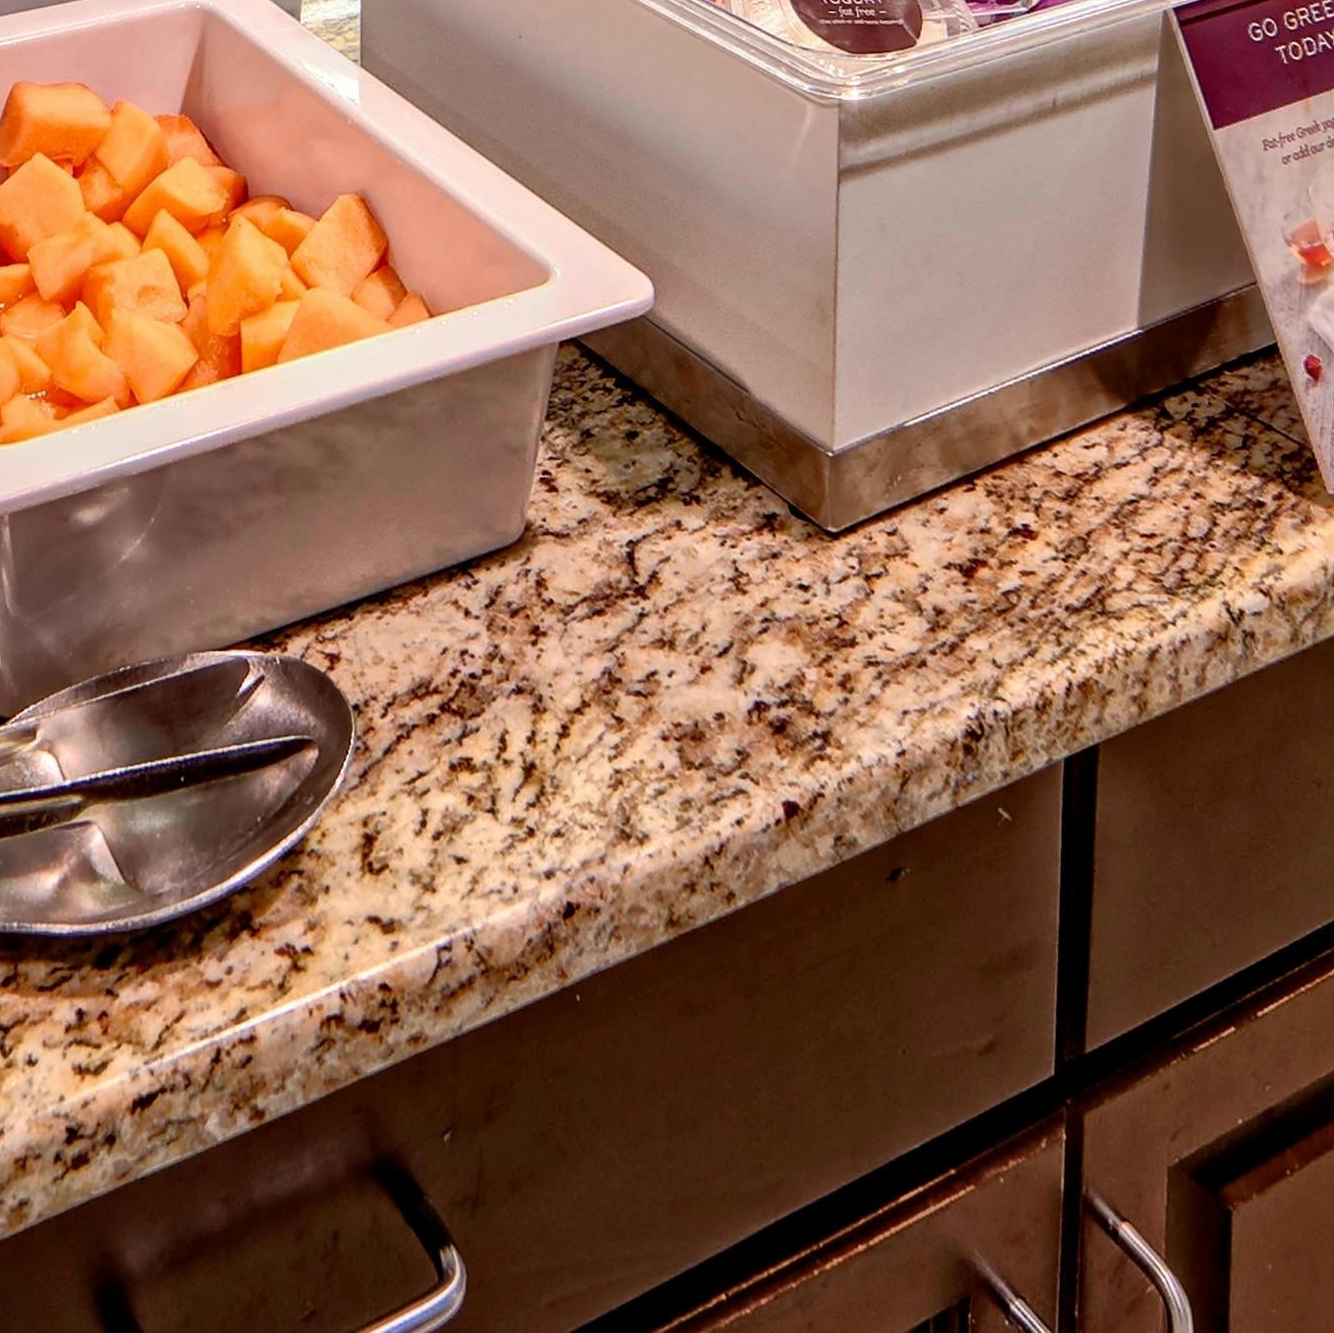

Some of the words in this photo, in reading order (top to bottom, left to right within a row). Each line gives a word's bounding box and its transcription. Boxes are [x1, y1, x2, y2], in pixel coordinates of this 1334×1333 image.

[855, 6, 876, 18] free
[1247, 17, 1278, 42] GO
[1281, 154, 1292, 166] or
